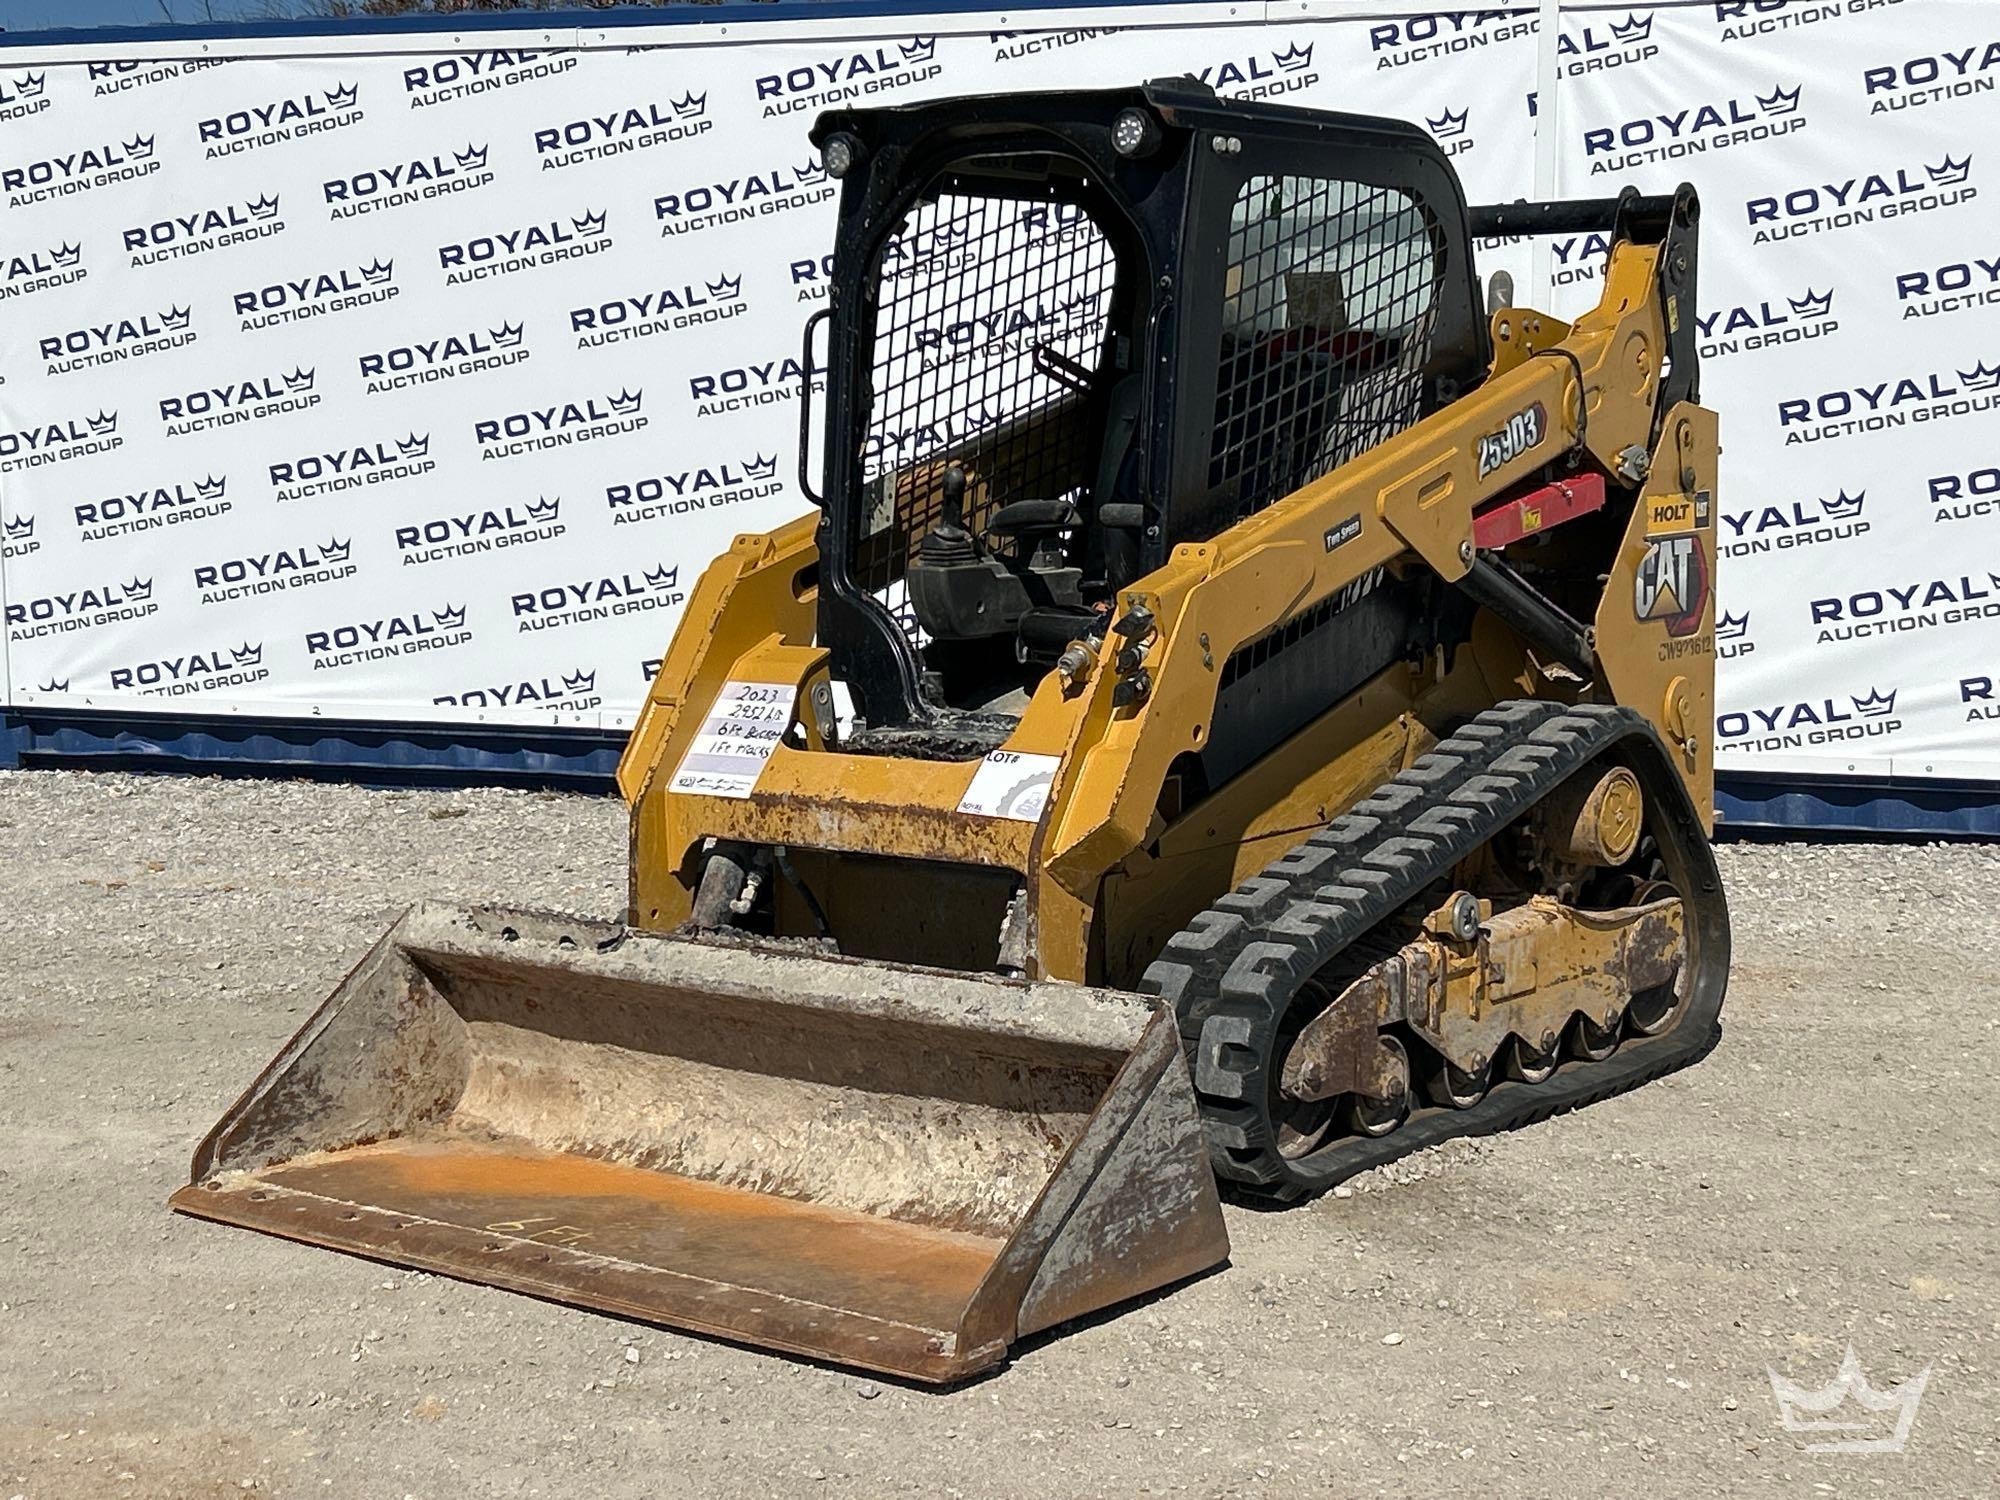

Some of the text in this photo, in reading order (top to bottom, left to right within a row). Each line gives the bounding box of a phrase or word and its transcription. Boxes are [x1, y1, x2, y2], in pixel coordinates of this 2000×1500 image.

[1721, 3, 1841, 42] AUCTION
[994, 29, 1097, 63] AUCTION
[1376, 32, 1488, 71] AUCTION
[1568, 45, 1659, 77] GROUP
[94, 65, 179, 98] AUCTION
[411, 57, 577, 109] AUCTION GROUP
[755, 48, 900, 101] ROYAL
[1864, 42, 2000, 95] ROYA
[0, 98, 51, 122] ROUP
[762, 64, 942, 119] AUCTION GROUP
[1870, 76, 1994, 115] AUCTION
[198, 95, 326, 143] ROYAL
[205, 110, 364, 160] AUCTION GROUP
[534, 103, 672, 154] ROYAL
[1584, 99, 1756, 156] ROYAL
[542, 120, 713, 171] AUCTION GROUP
[1590, 117, 1807, 176] AUCTION GROUP
[1, 145, 124, 193] ROYAL
[9, 161, 161, 209] AUCTION GROUP
[323, 156, 456, 204] ROYAL
[330, 172, 494, 221] AUCTION GROUP
[654, 170, 795, 220] ROYAL
[661, 187, 835, 238] AUCTION GROUP
[1746, 169, 1925, 226] ROYAL
[1753, 187, 1977, 246] AUCTION GROUP
[122, 206, 249, 252] ROYAL
[131, 221, 285, 268] AUCTION GROUP
[438, 221, 573, 269] ROYAL
[23, 268, 88, 294] GROUP
[446, 238, 613, 286] AUCTION GROUP
[1896, 256, 2000, 300] ROY
[233, 270, 362, 315] ROYAL
[241, 286, 400, 332] AUCTION GROUP
[570, 285, 708, 333] ROYAL
[1902, 288, 2000, 320] AUCTIO
[39, 316, 161, 360] ROYAL
[577, 302, 747, 350] AUCTION GROUP
[1696, 301, 1788, 338] YAL
[1744, 321, 1839, 350] GROUP
[47, 332, 197, 376] AUCTION GROUP
[359, 332, 491, 378] ROYAL
[366, 350, 530, 395] AUCTION GROUP
[159, 377, 284, 421] ROYAL
[166, 394, 321, 438] AUCTION GROUP
[697, 387, 791, 418] AUCTION
[1778, 373, 1957, 427] ROYAL
[0, 420, 89, 456] OYAL
[474, 399, 609, 444] ROYAL
[482, 417, 649, 461] AUCTION GROUP
[1478, 408, 1538, 479] 259D3
[1785, 412, 1906, 446] AUCTION
[1, 437, 123, 473] CTION GROUP
[269, 443, 398, 486] ROYAL
[276, 460, 436, 503] AUCTION GROUP
[606, 465, 744, 509] ROYAL
[74, 485, 197, 526] ROYAL
[82, 501, 232, 542] AUCTION GROUP
[614, 482, 783, 526] AUCTION GROUP
[1653, 504, 1690, 523] HOLT
[1720, 502, 1820, 537] YAL
[395, 507, 527, 550] ROYAL
[403, 524, 566, 566] AUCTION GROUP
[1776, 522, 1871, 549] GROUP
[194, 547, 320, 589] ROYAL
[201, 565, 357, 605] AUCTION GROUP
[1635, 538, 1693, 618] CAT
[4, 586, 123, 626] ROYAL
[511, 575, 645, 616] ROYAL
[519, 592, 684, 633] AUCTION GROUP
[1810, 576, 1989, 625] ROYAL
[11, 603, 159, 642] AUCTION GROUP
[305, 614, 435, 654] ROYAL
[1817, 603, 2000, 644] AUCTION GRO
[110, 651, 233, 690] ROYAL
[314, 631, 472, 670] AUCTION GROUP
[202, 668, 269, 690] GROUP
[736, 685, 779, 704] 2023
[718, 722, 728, 736] 6
[1716, 699, 1852, 738] OYAL
[1808, 720, 1902, 745] GROUP
[986, 752, 1020, 764] LOT#
